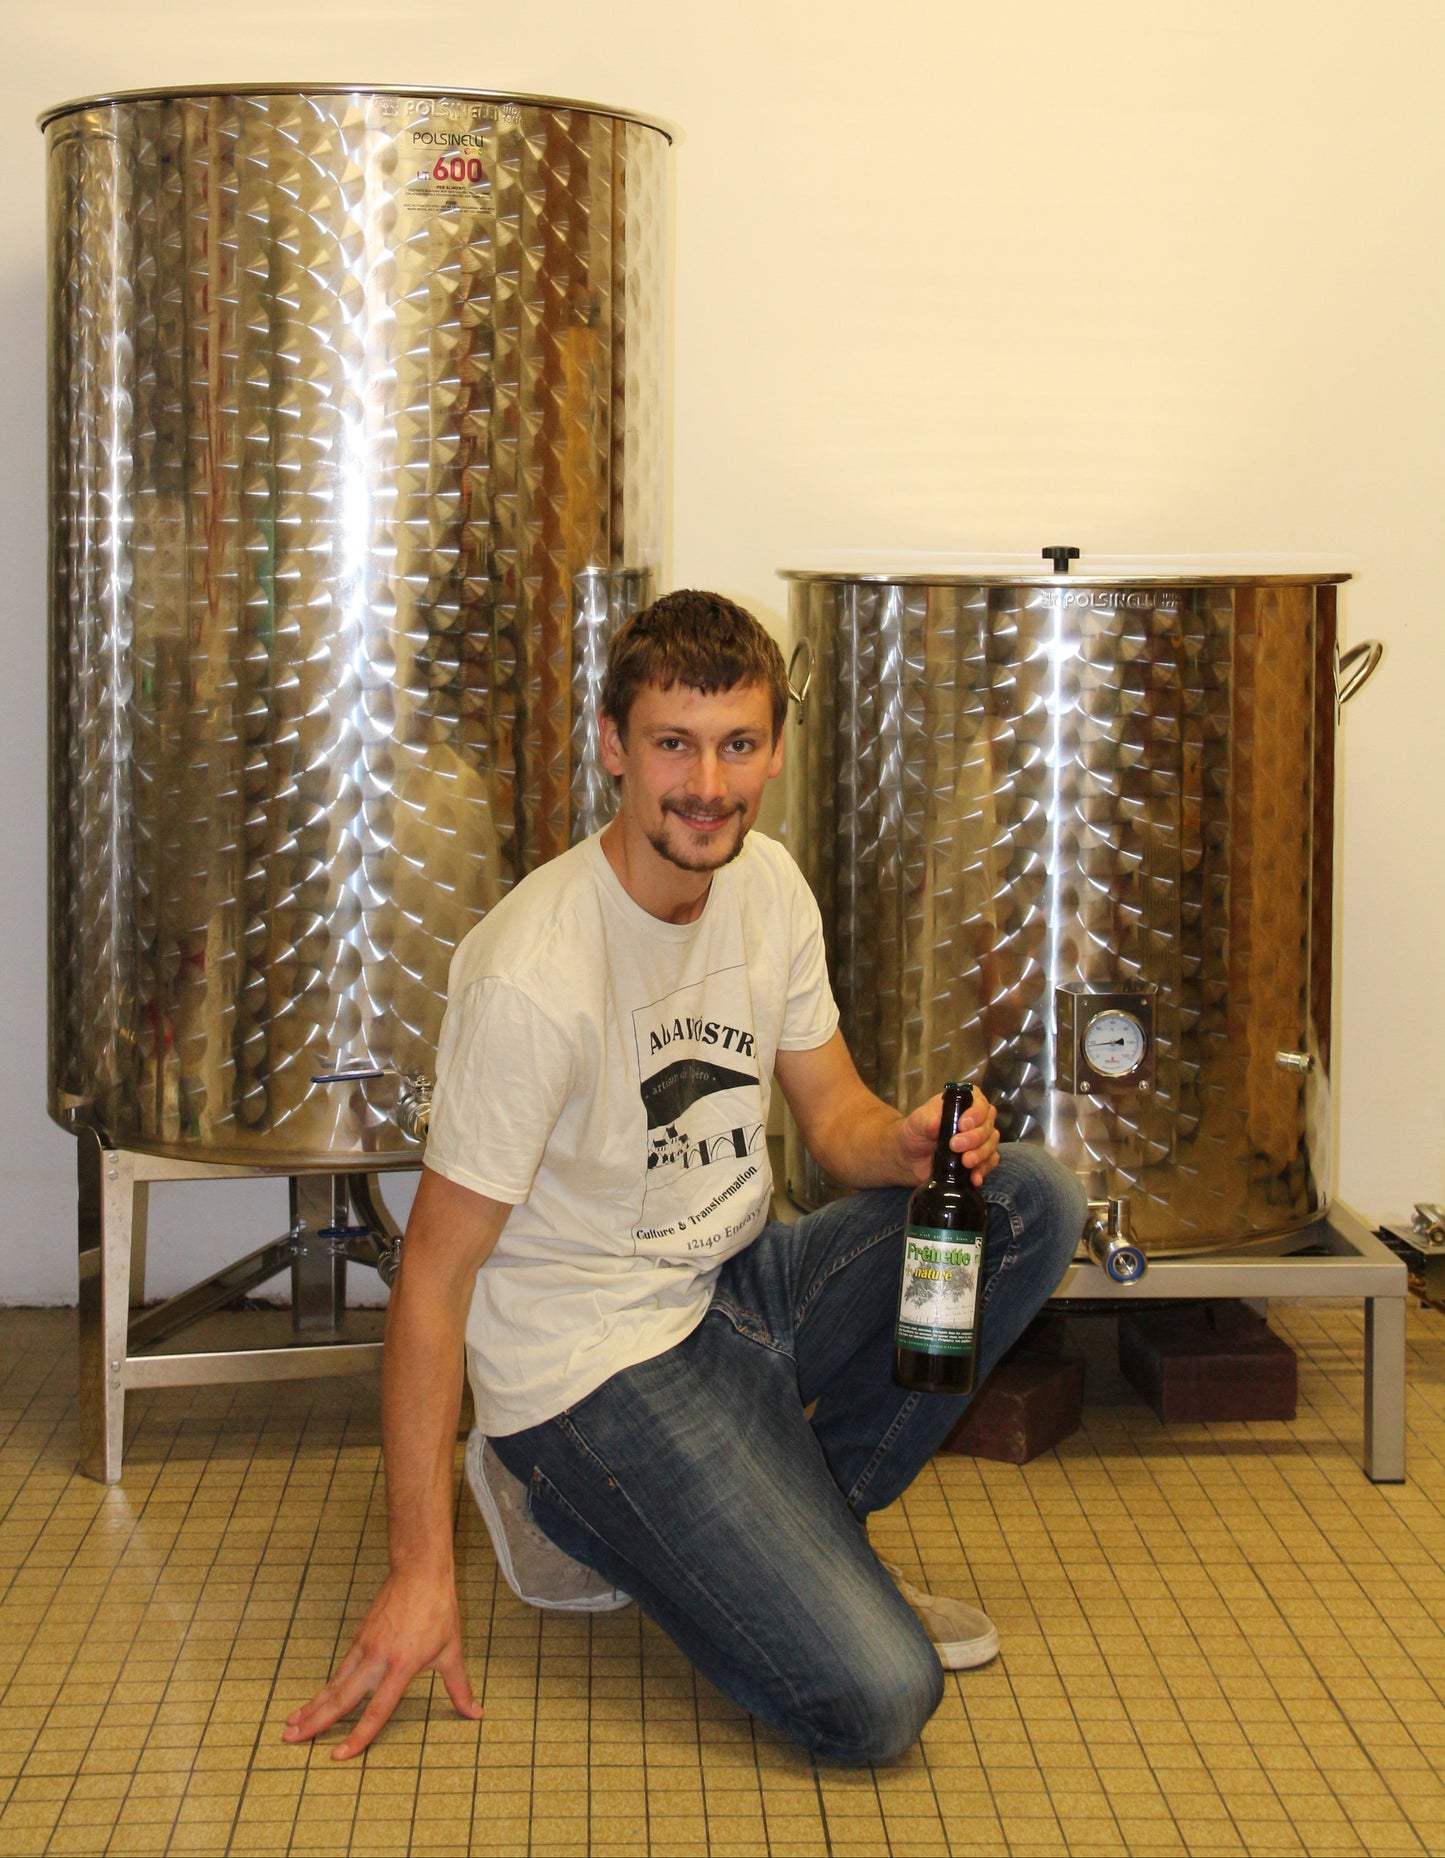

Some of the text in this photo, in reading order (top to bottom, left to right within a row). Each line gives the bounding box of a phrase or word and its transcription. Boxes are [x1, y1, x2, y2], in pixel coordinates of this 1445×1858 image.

[412, 131, 484, 147] POLSINELLI
[432, 156, 483, 183] 600
[636, 1165, 758, 1241] Culture & Transformation
[687, 1234, 721, 1251] 12140
[914, 1267, 953, 1282] nature
